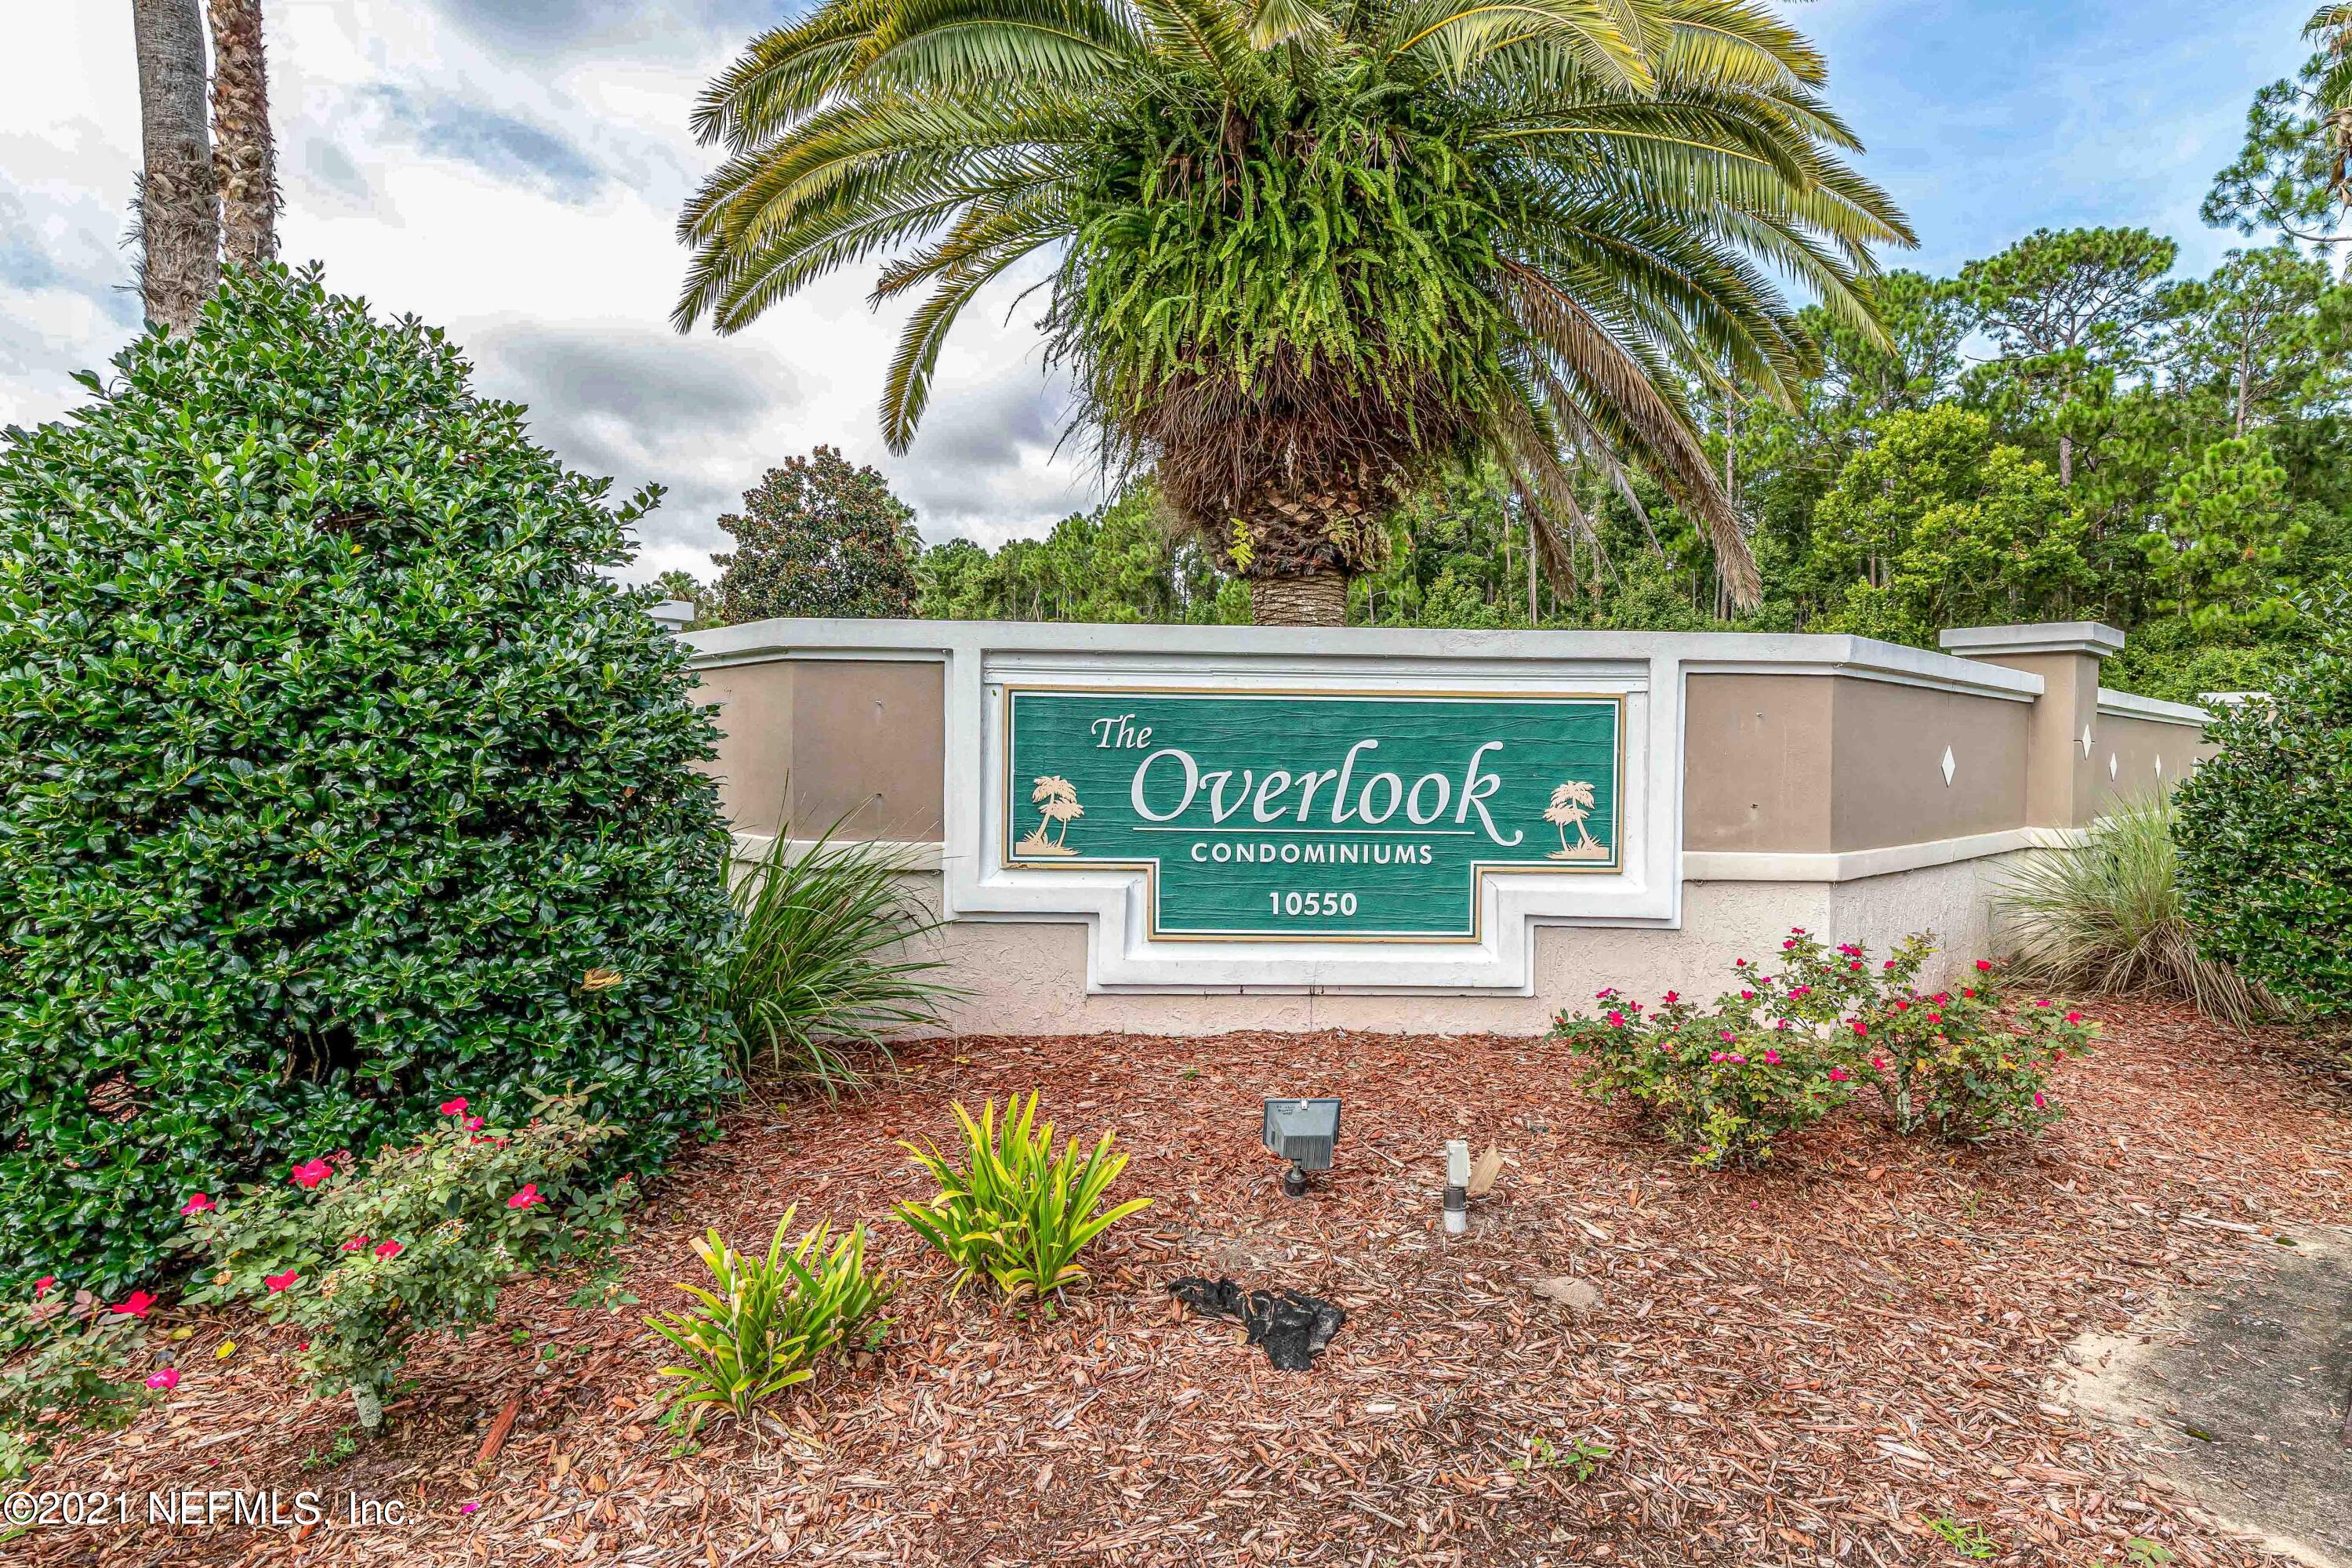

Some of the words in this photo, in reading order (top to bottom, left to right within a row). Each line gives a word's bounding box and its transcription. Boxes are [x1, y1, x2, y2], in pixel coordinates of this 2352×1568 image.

[1091, 713, 1152, 749] The
[1131, 739, 1523, 847] Overlook
[1191, 842, 1433, 865] CONDOMINIUMS
[1268, 891, 1358, 916] 10550
